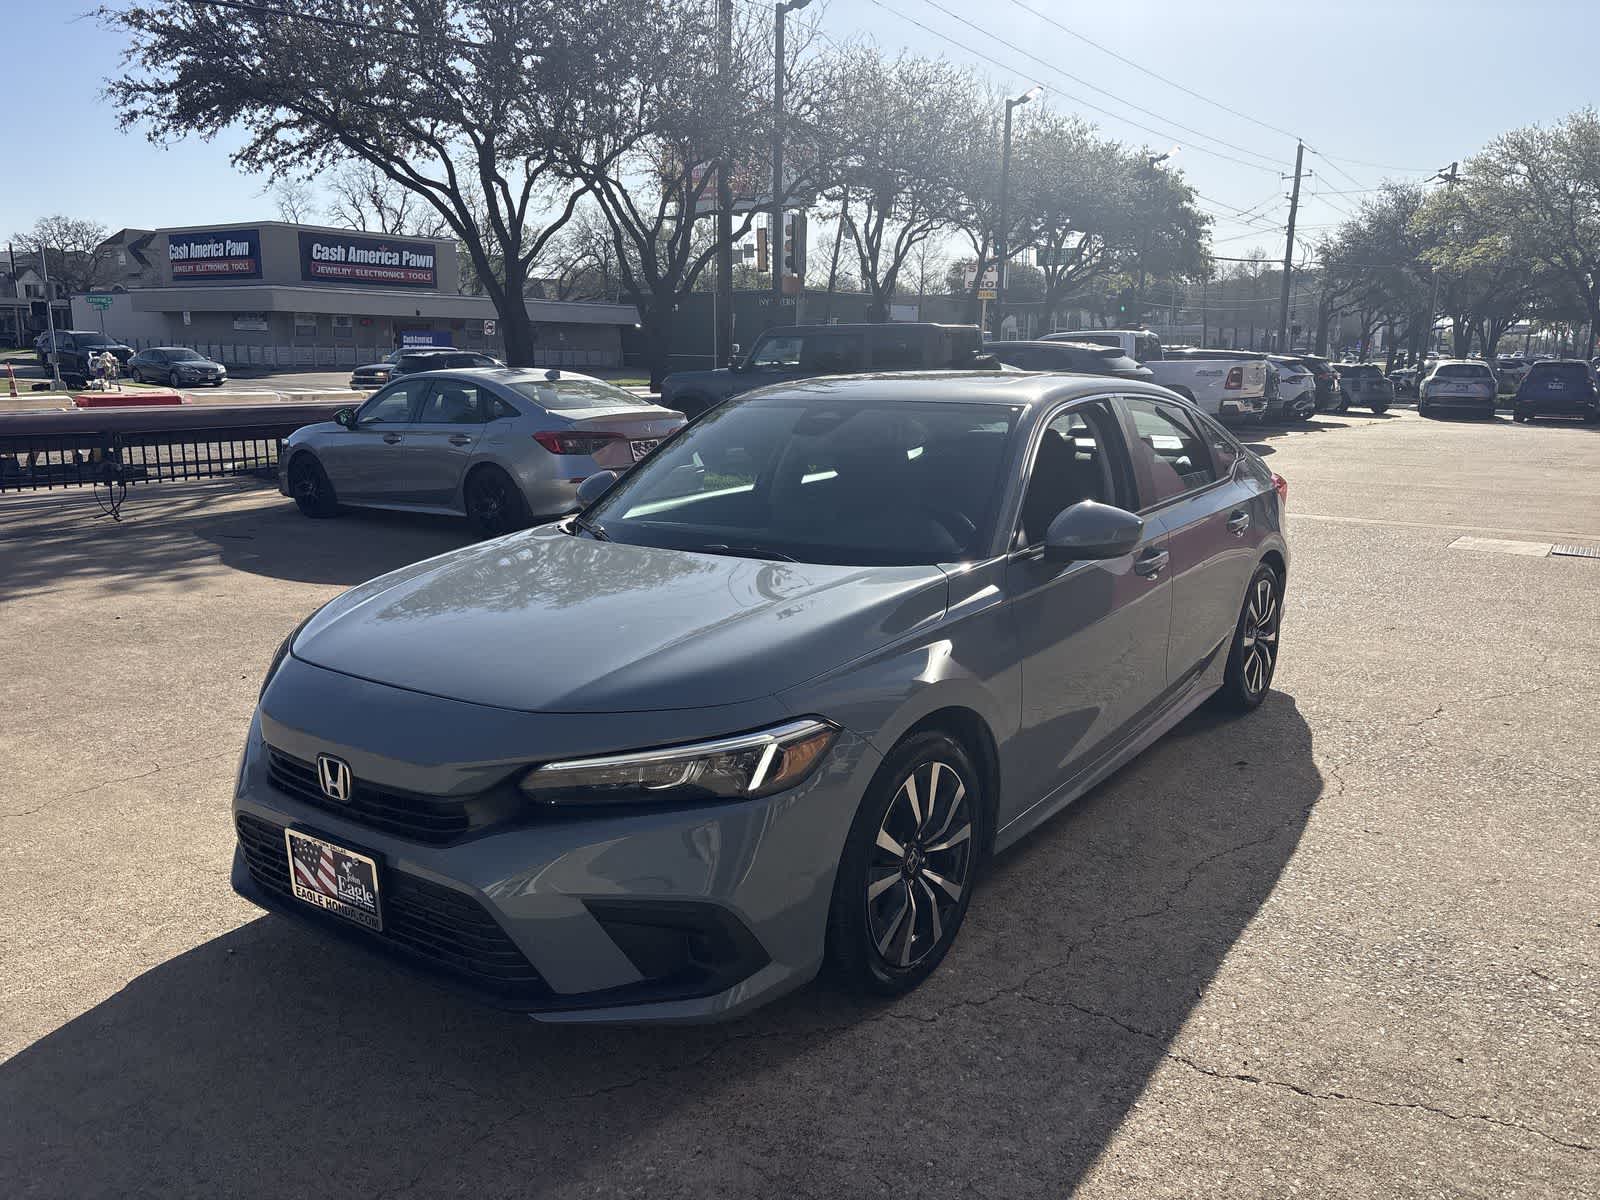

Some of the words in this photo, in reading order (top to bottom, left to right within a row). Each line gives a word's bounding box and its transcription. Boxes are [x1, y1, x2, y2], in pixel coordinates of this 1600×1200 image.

[169, 243, 188, 260] Cash
[190, 242, 224, 259] America
[225, 240, 249, 256] Pawn
[312, 243, 345, 261] Cash
[347, 246, 399, 265] America
[402, 250, 433, 268] Pawn
[196, 263, 229, 272] ELECTRONICS
[231, 262, 249, 271] TOOLS
[316, 266, 352, 275] JEWELRY
[355, 269, 405, 279] ELECTRONICS
[408, 272, 432, 281] TOOLS
[295, 884, 323, 905] EAGLE
[336, 874, 374, 904] Eagle
